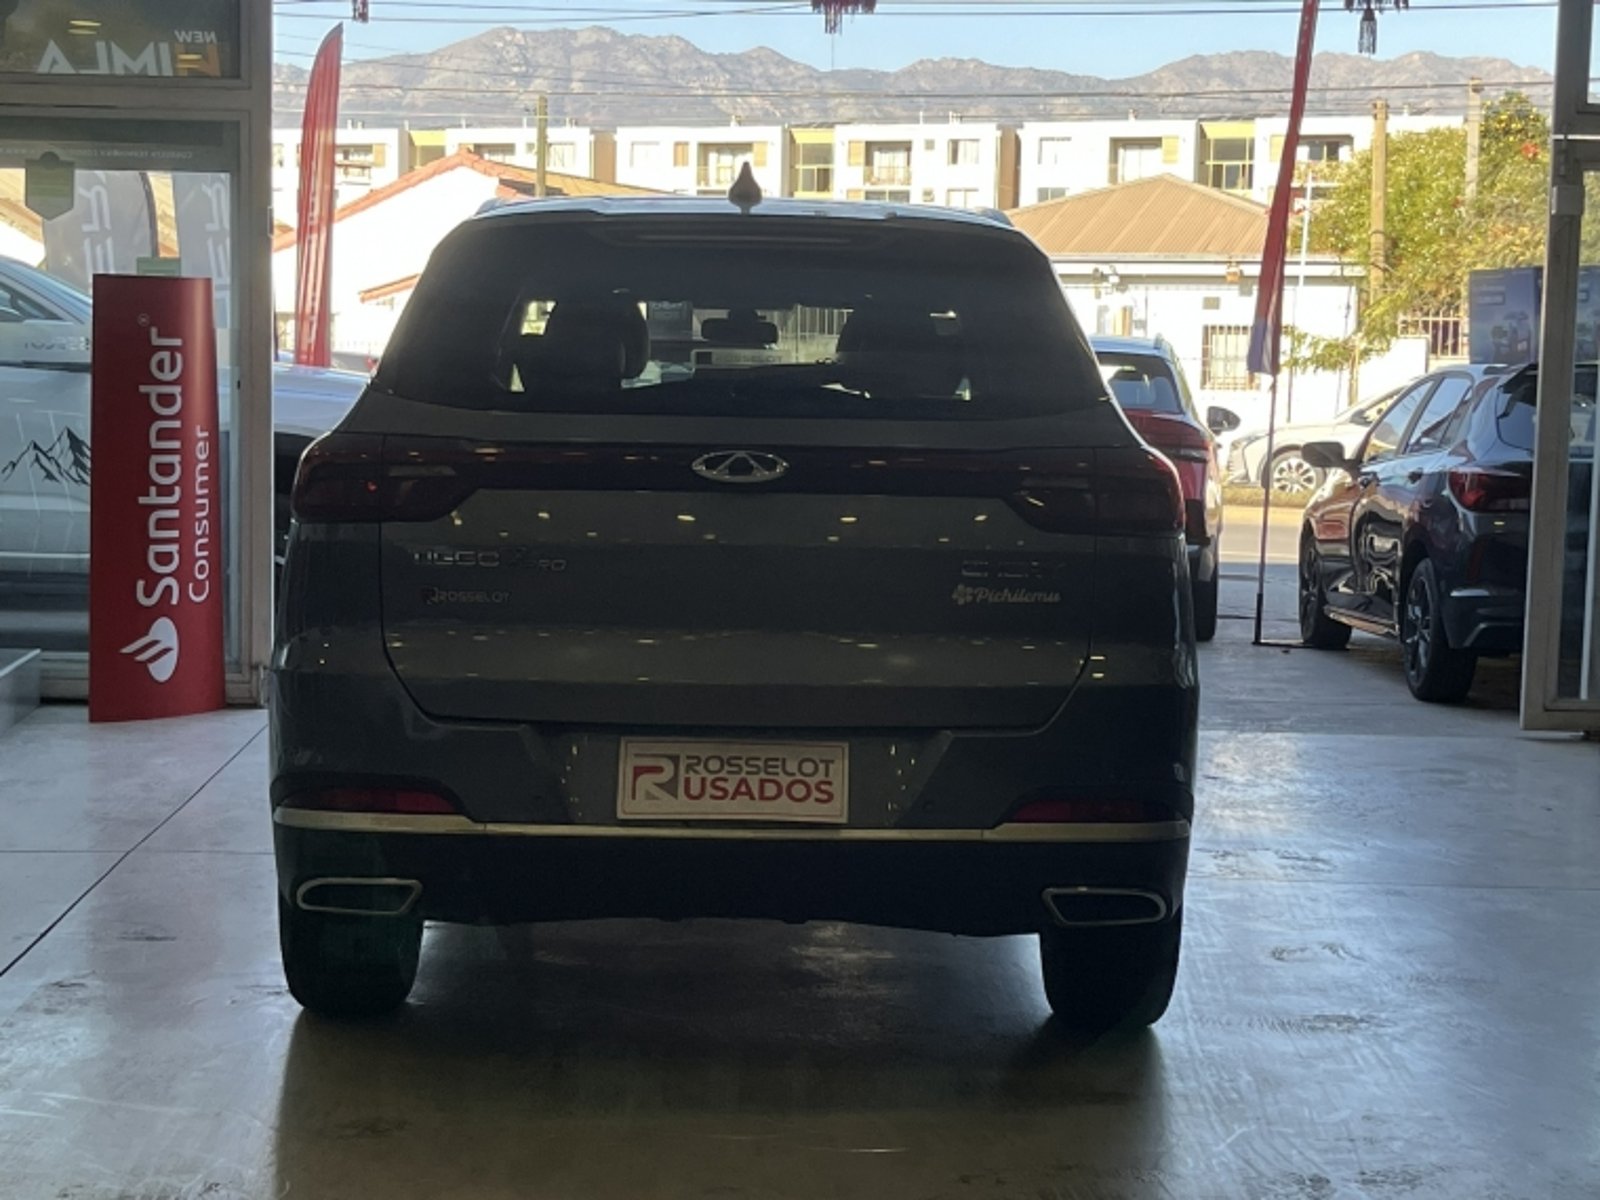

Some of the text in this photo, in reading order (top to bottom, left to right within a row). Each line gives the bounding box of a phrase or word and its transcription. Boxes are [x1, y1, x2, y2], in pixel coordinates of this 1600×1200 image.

[136, 326, 184, 606] Santander
[188, 424, 210, 603] Consumer
[684, 777, 834, 804] USADOS
[685, 755, 835, 778] ROSSELOT
